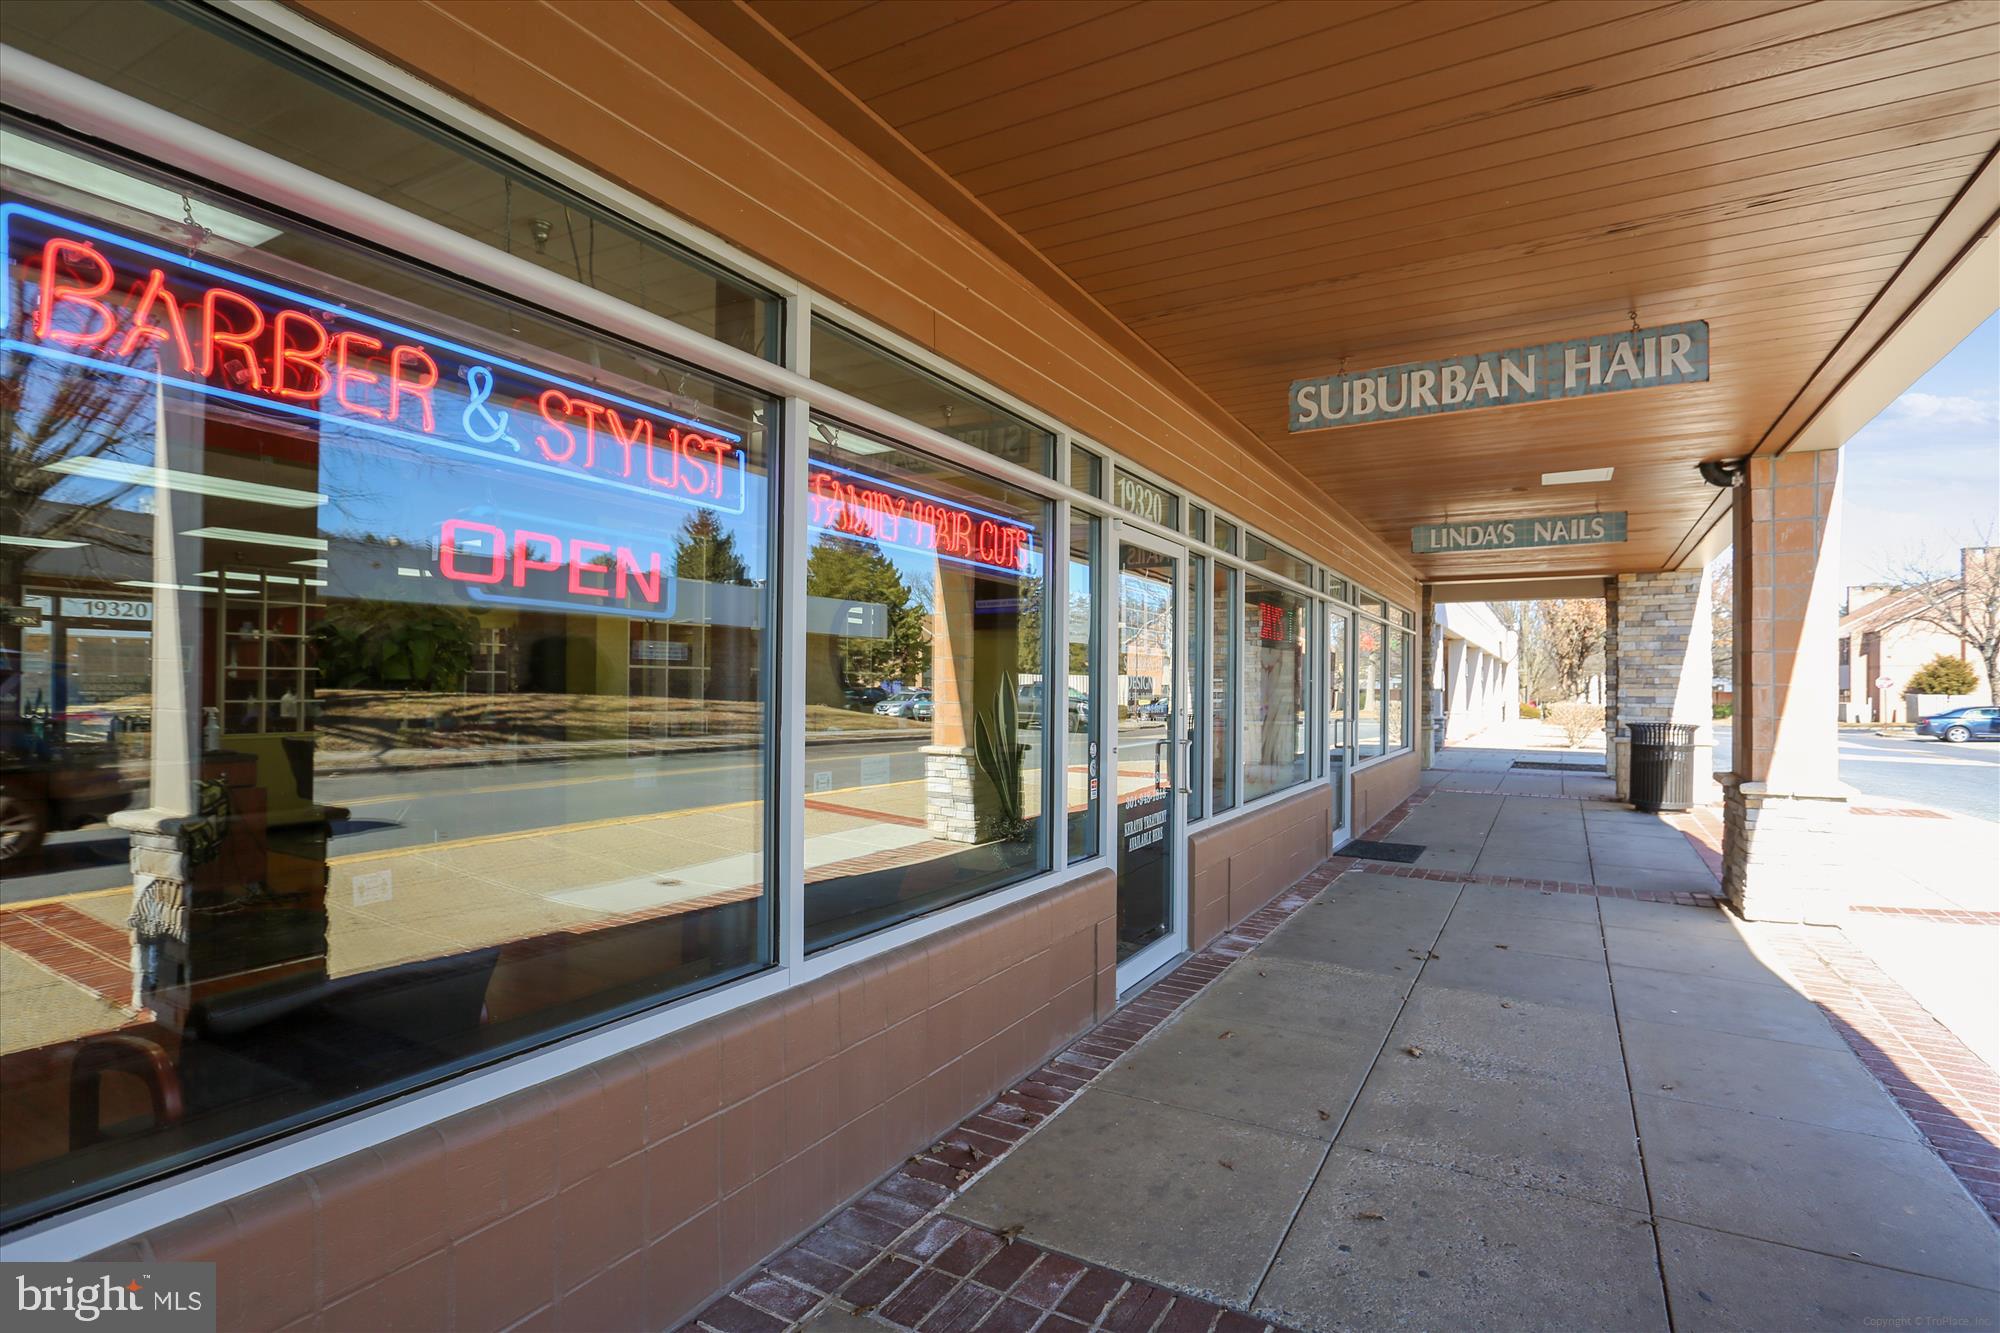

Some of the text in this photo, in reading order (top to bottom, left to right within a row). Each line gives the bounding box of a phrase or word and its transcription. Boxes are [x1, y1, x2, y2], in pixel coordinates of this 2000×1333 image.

[35, 238, 731, 499] BARBER & STYLIST
[1296, 333, 1696, 423] SUBURBAN HAIR
[812, 473, 1028, 569] FAMILY HAIR CUTS
[1118, 477, 1162, 525] 19320
[1430, 518, 1605, 548] LINDA'S NAILS
[440, 518, 661, 603] OPEN
[83, 600, 148, 618] 19320
